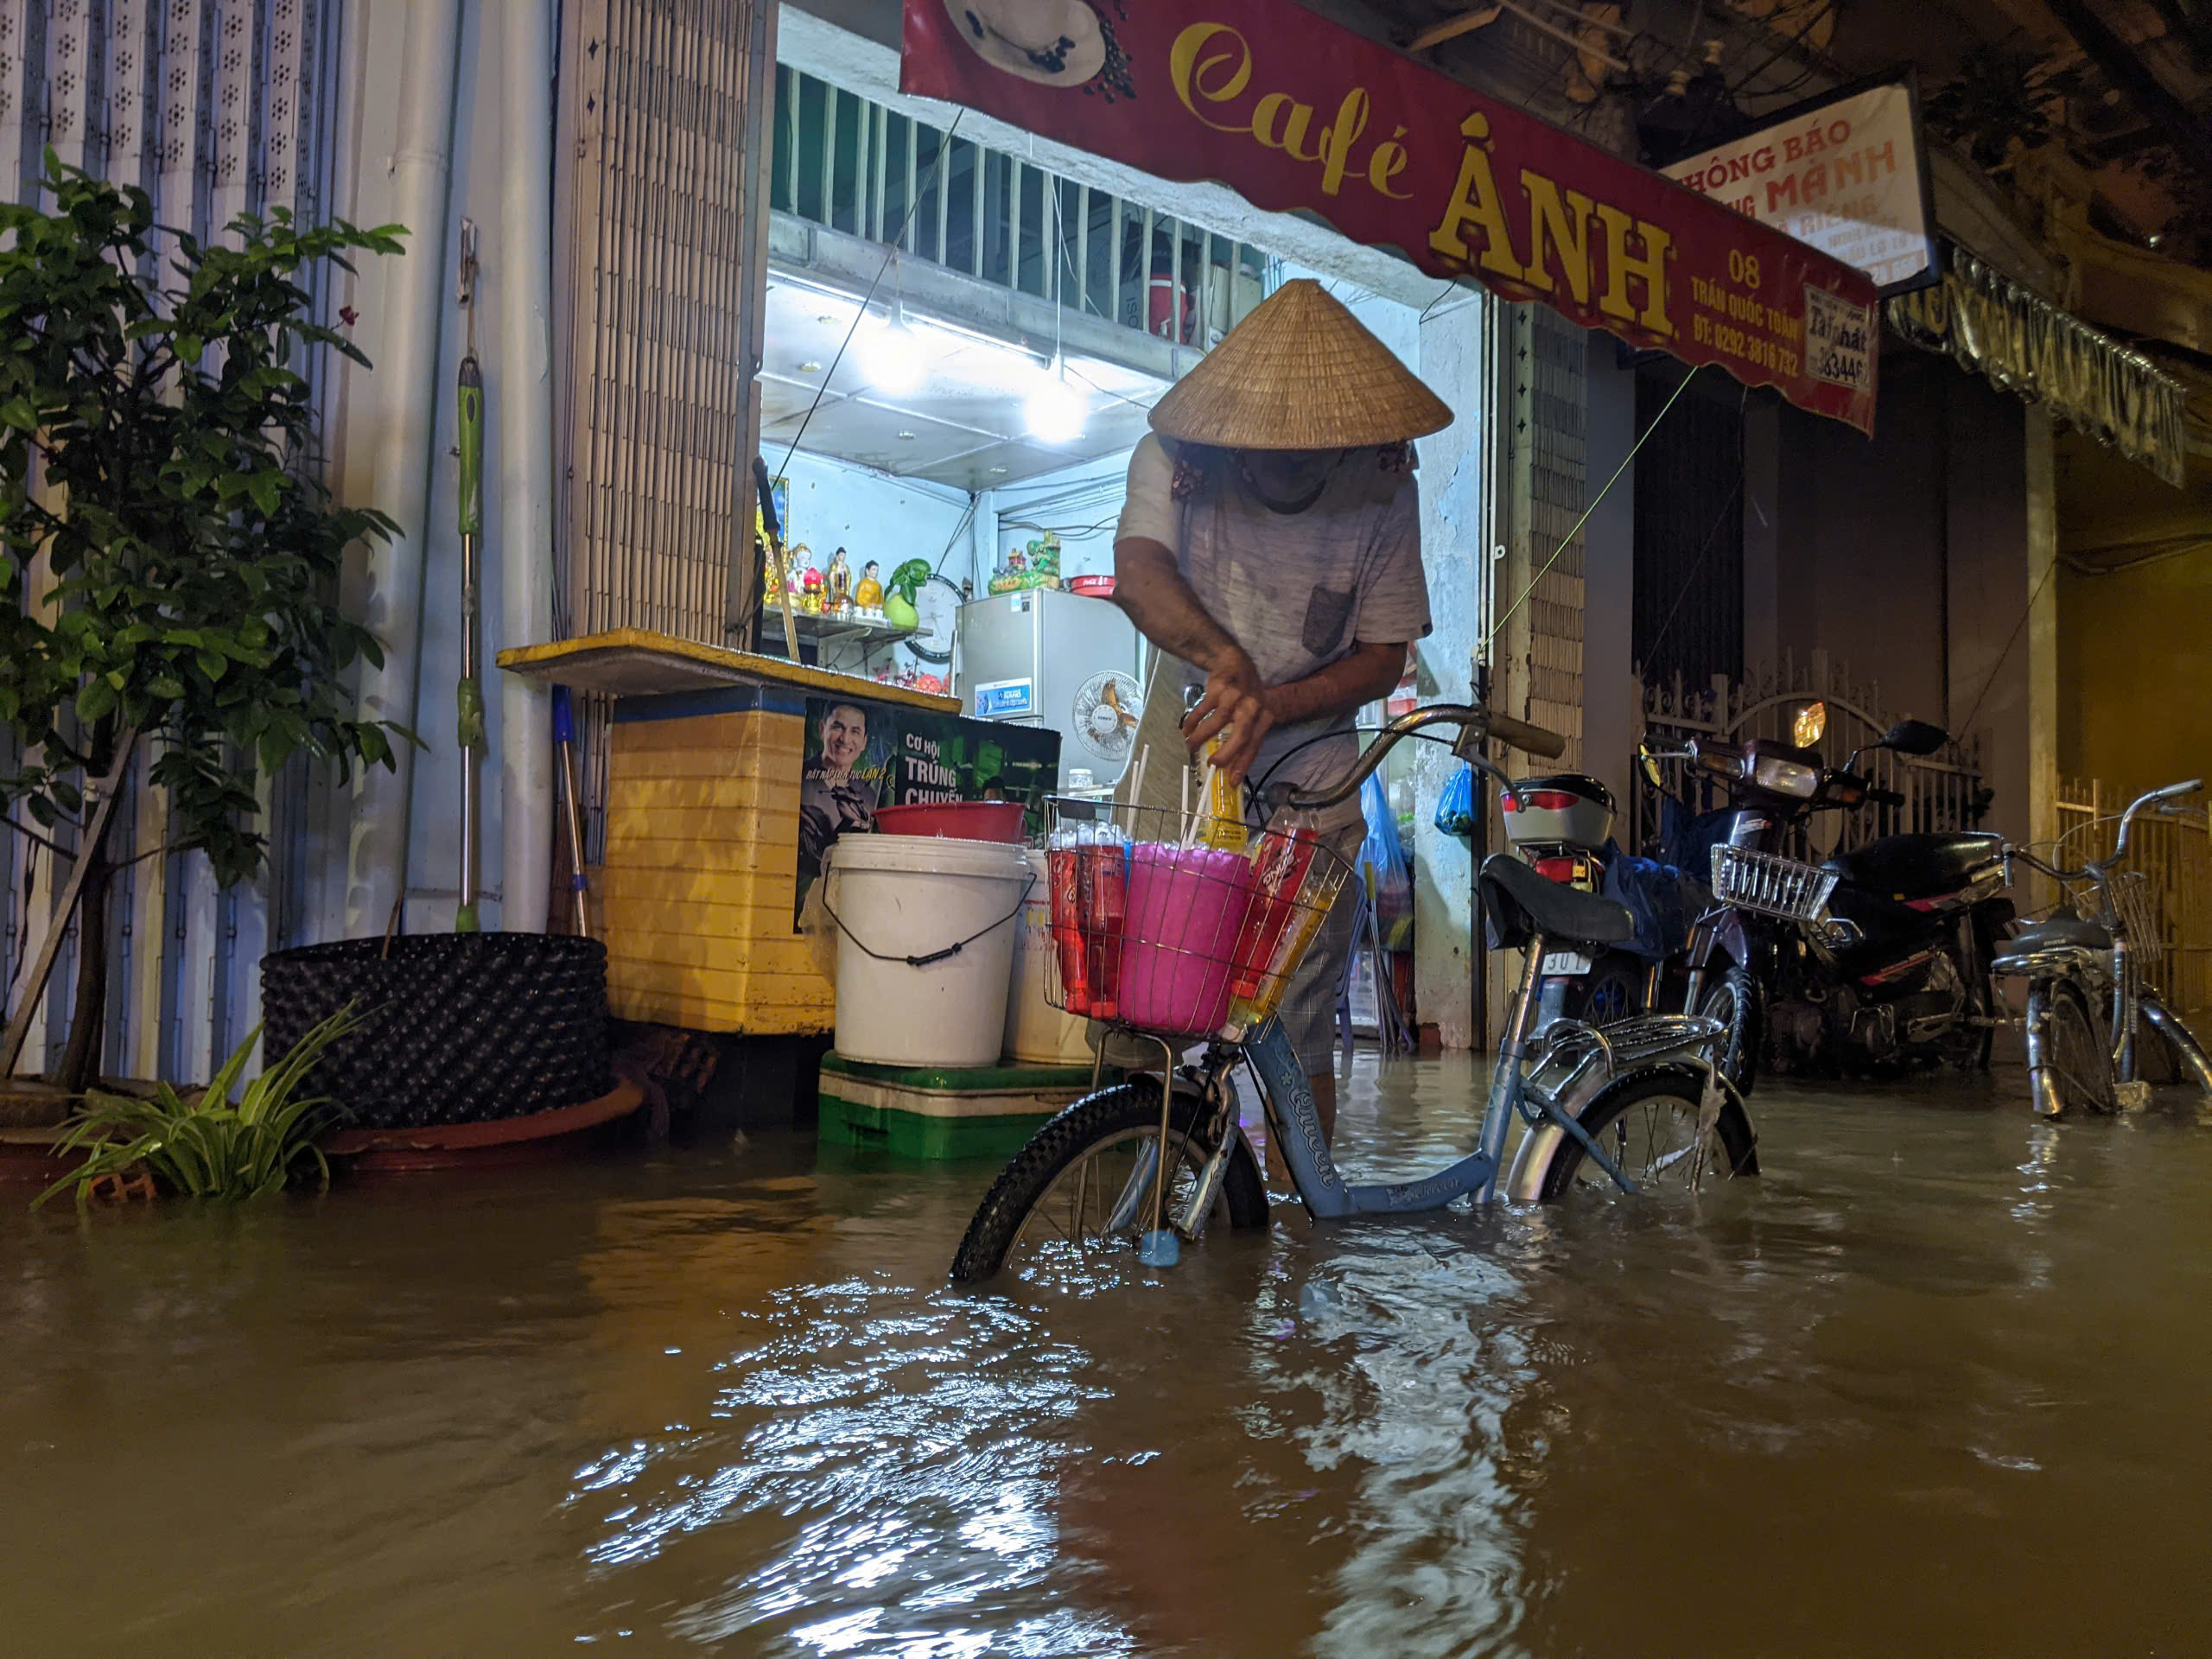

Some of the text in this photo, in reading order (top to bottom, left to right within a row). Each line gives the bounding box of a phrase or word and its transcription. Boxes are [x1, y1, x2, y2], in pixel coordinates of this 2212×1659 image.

[1170, 22, 1414, 200] Café
[1783, 119, 1851, 163] BÁO
[1729, 249, 1760, 289] 08
[906, 733, 940, 760] CƠ HỘI
[879, 766, 887, 779] 2
[906, 755, 957, 788] TRÚNG
[1287, 1088, 1336, 1189] Queen
